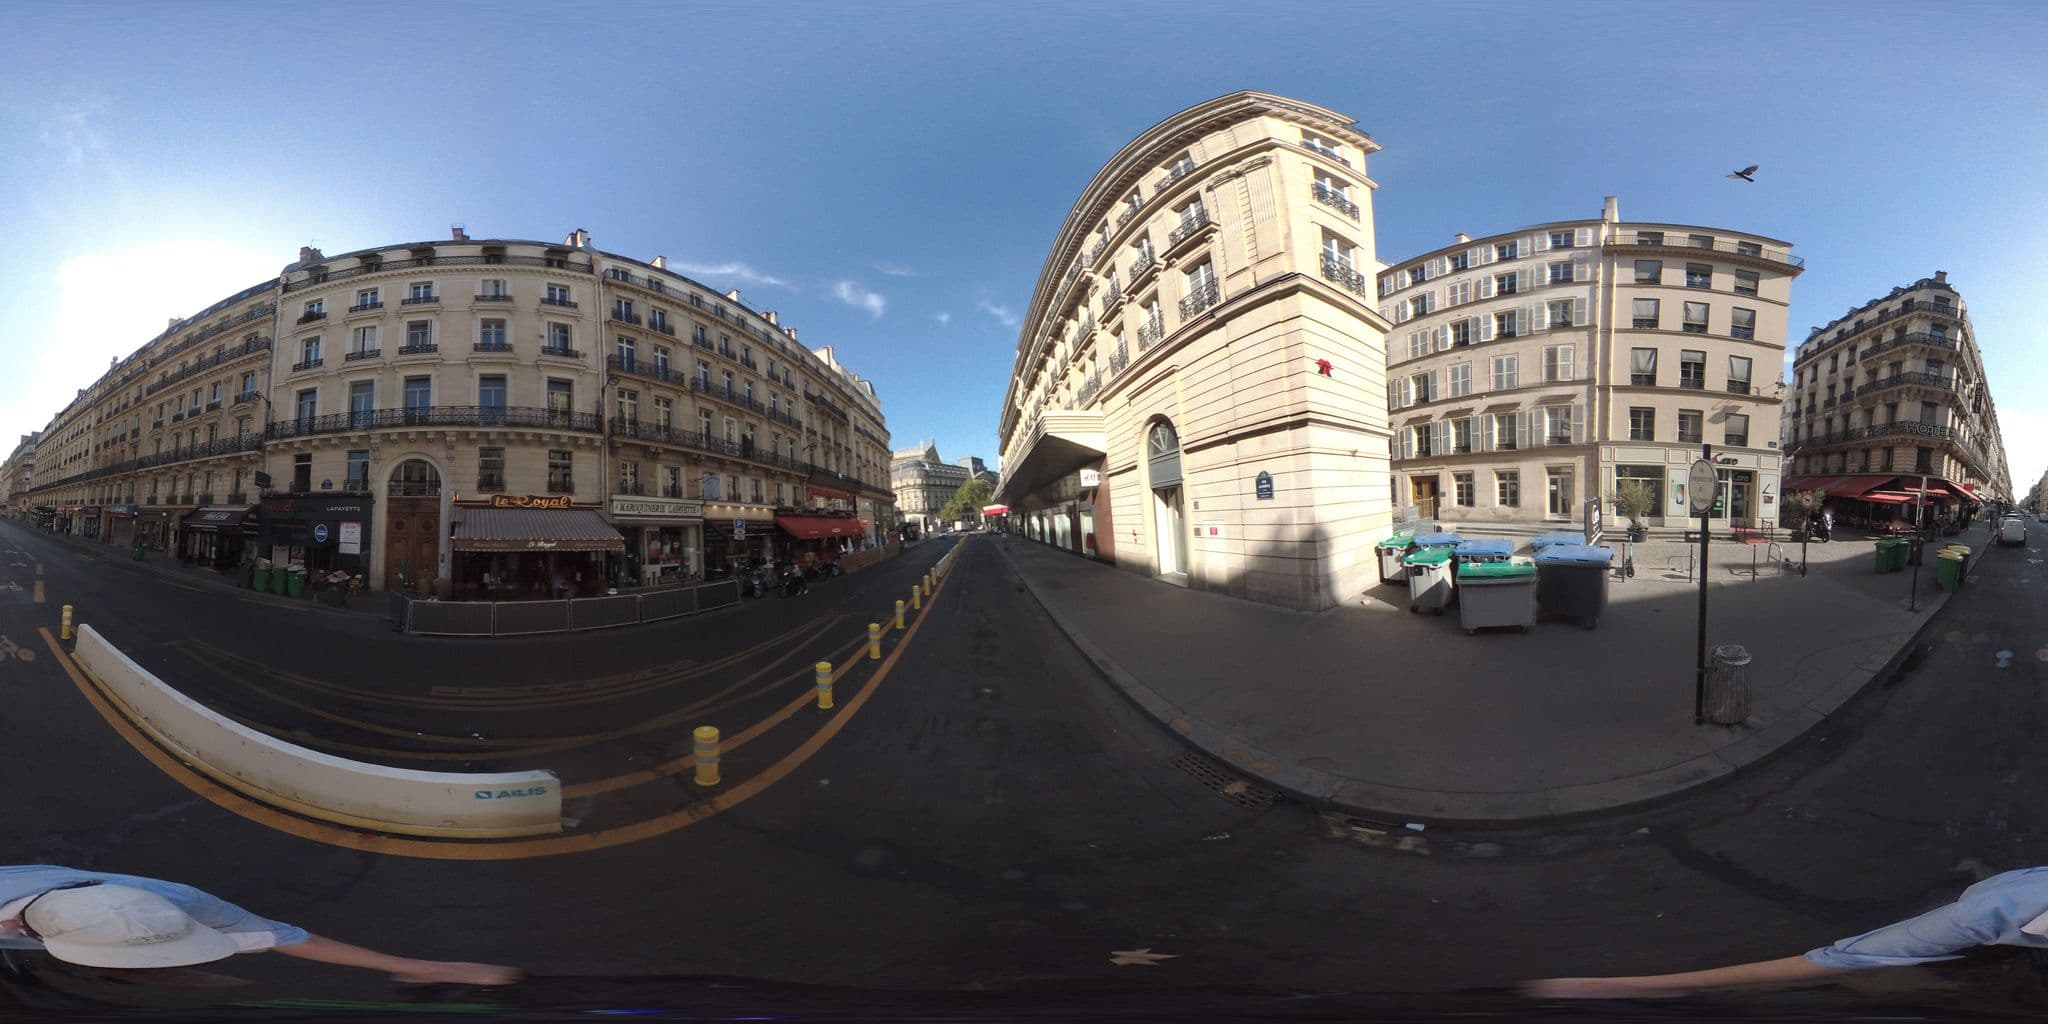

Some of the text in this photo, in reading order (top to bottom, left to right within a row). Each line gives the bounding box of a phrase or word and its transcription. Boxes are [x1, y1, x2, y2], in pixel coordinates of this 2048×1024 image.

[1906, 422, 1953, 438] HOTEL
[511, 496, 569, 509] Royal
[618, 503, 666, 515] MAROQUINERIE
